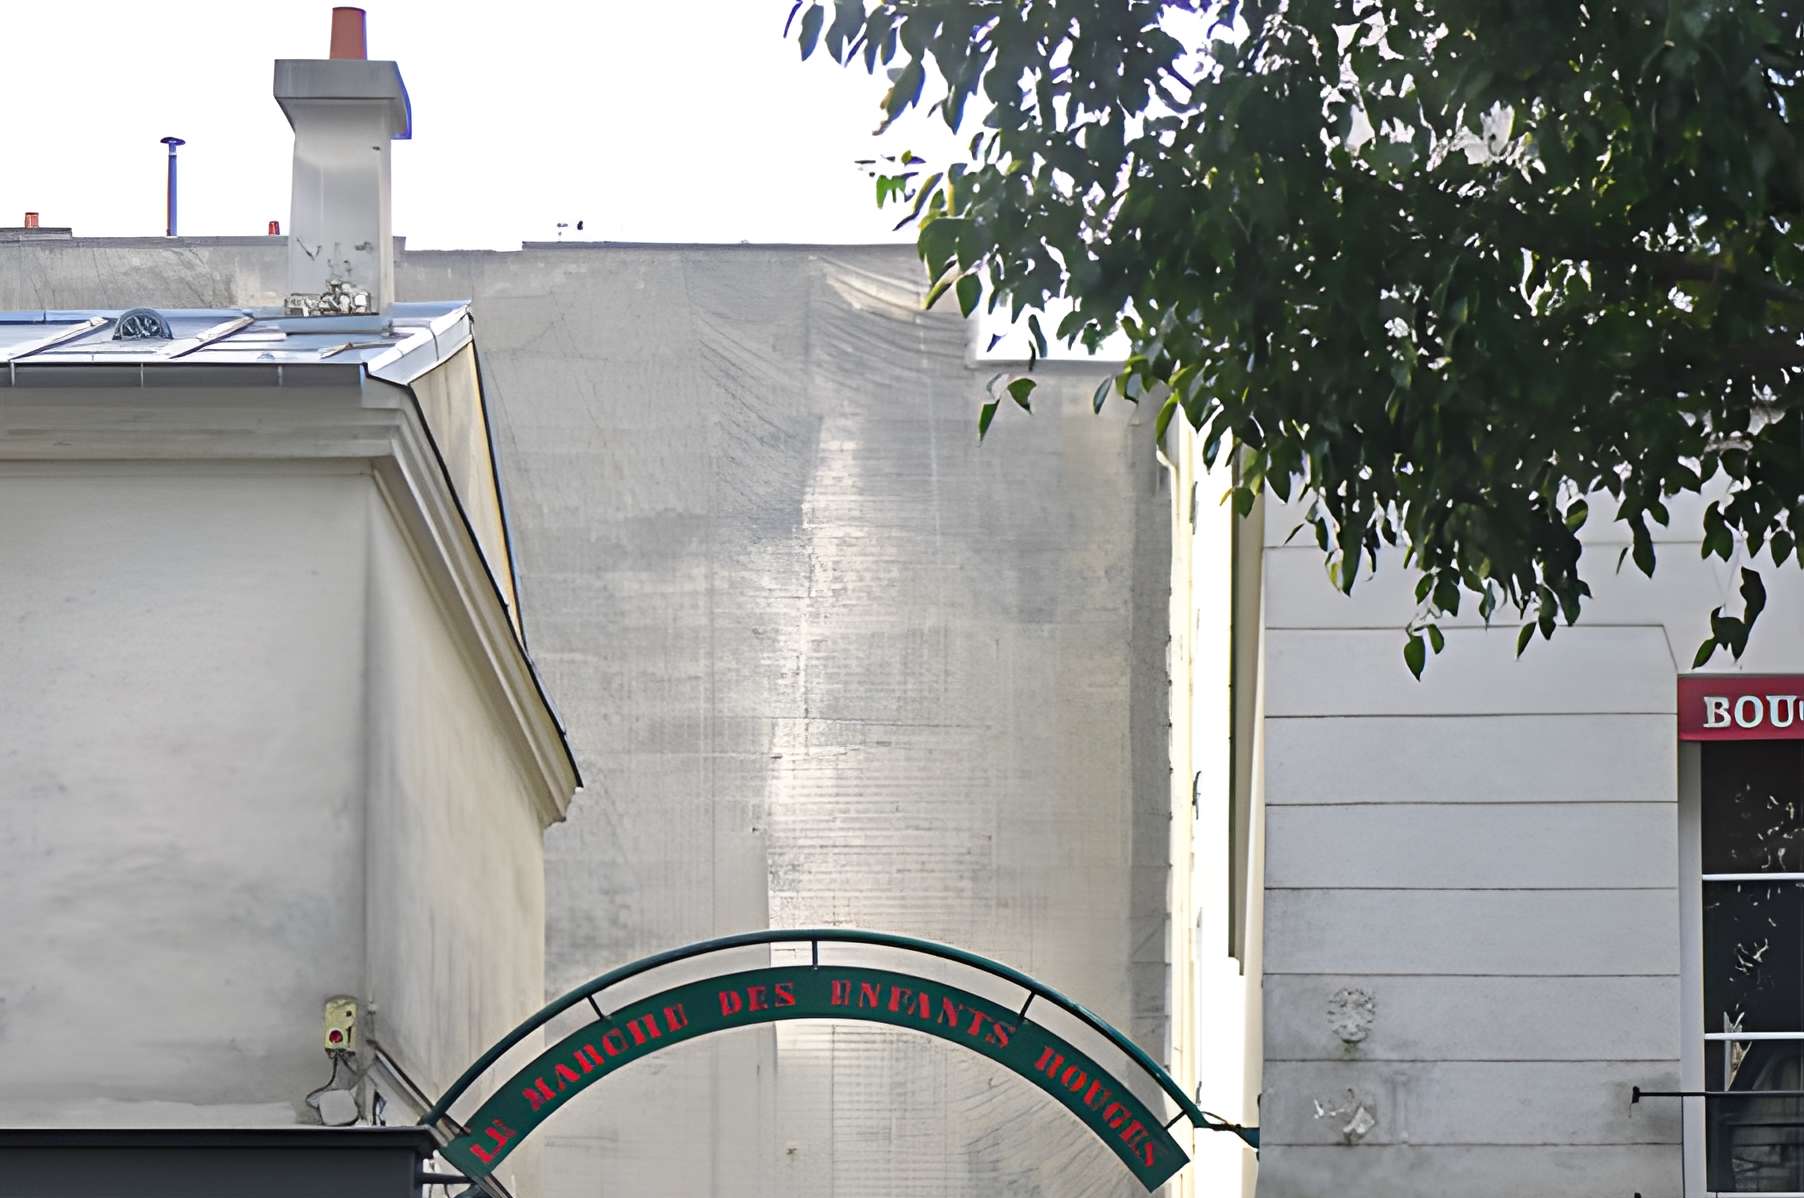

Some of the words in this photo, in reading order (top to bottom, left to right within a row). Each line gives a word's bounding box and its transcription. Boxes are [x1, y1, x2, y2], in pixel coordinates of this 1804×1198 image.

[1703, 695, 1804, 729] BOU
[469, 1119, 515, 1163] LE
[718, 984, 796, 1016] DES
[831, 979, 1015, 1048] ENFANTS
[1034, 1046, 1156, 1167] ROUGES
